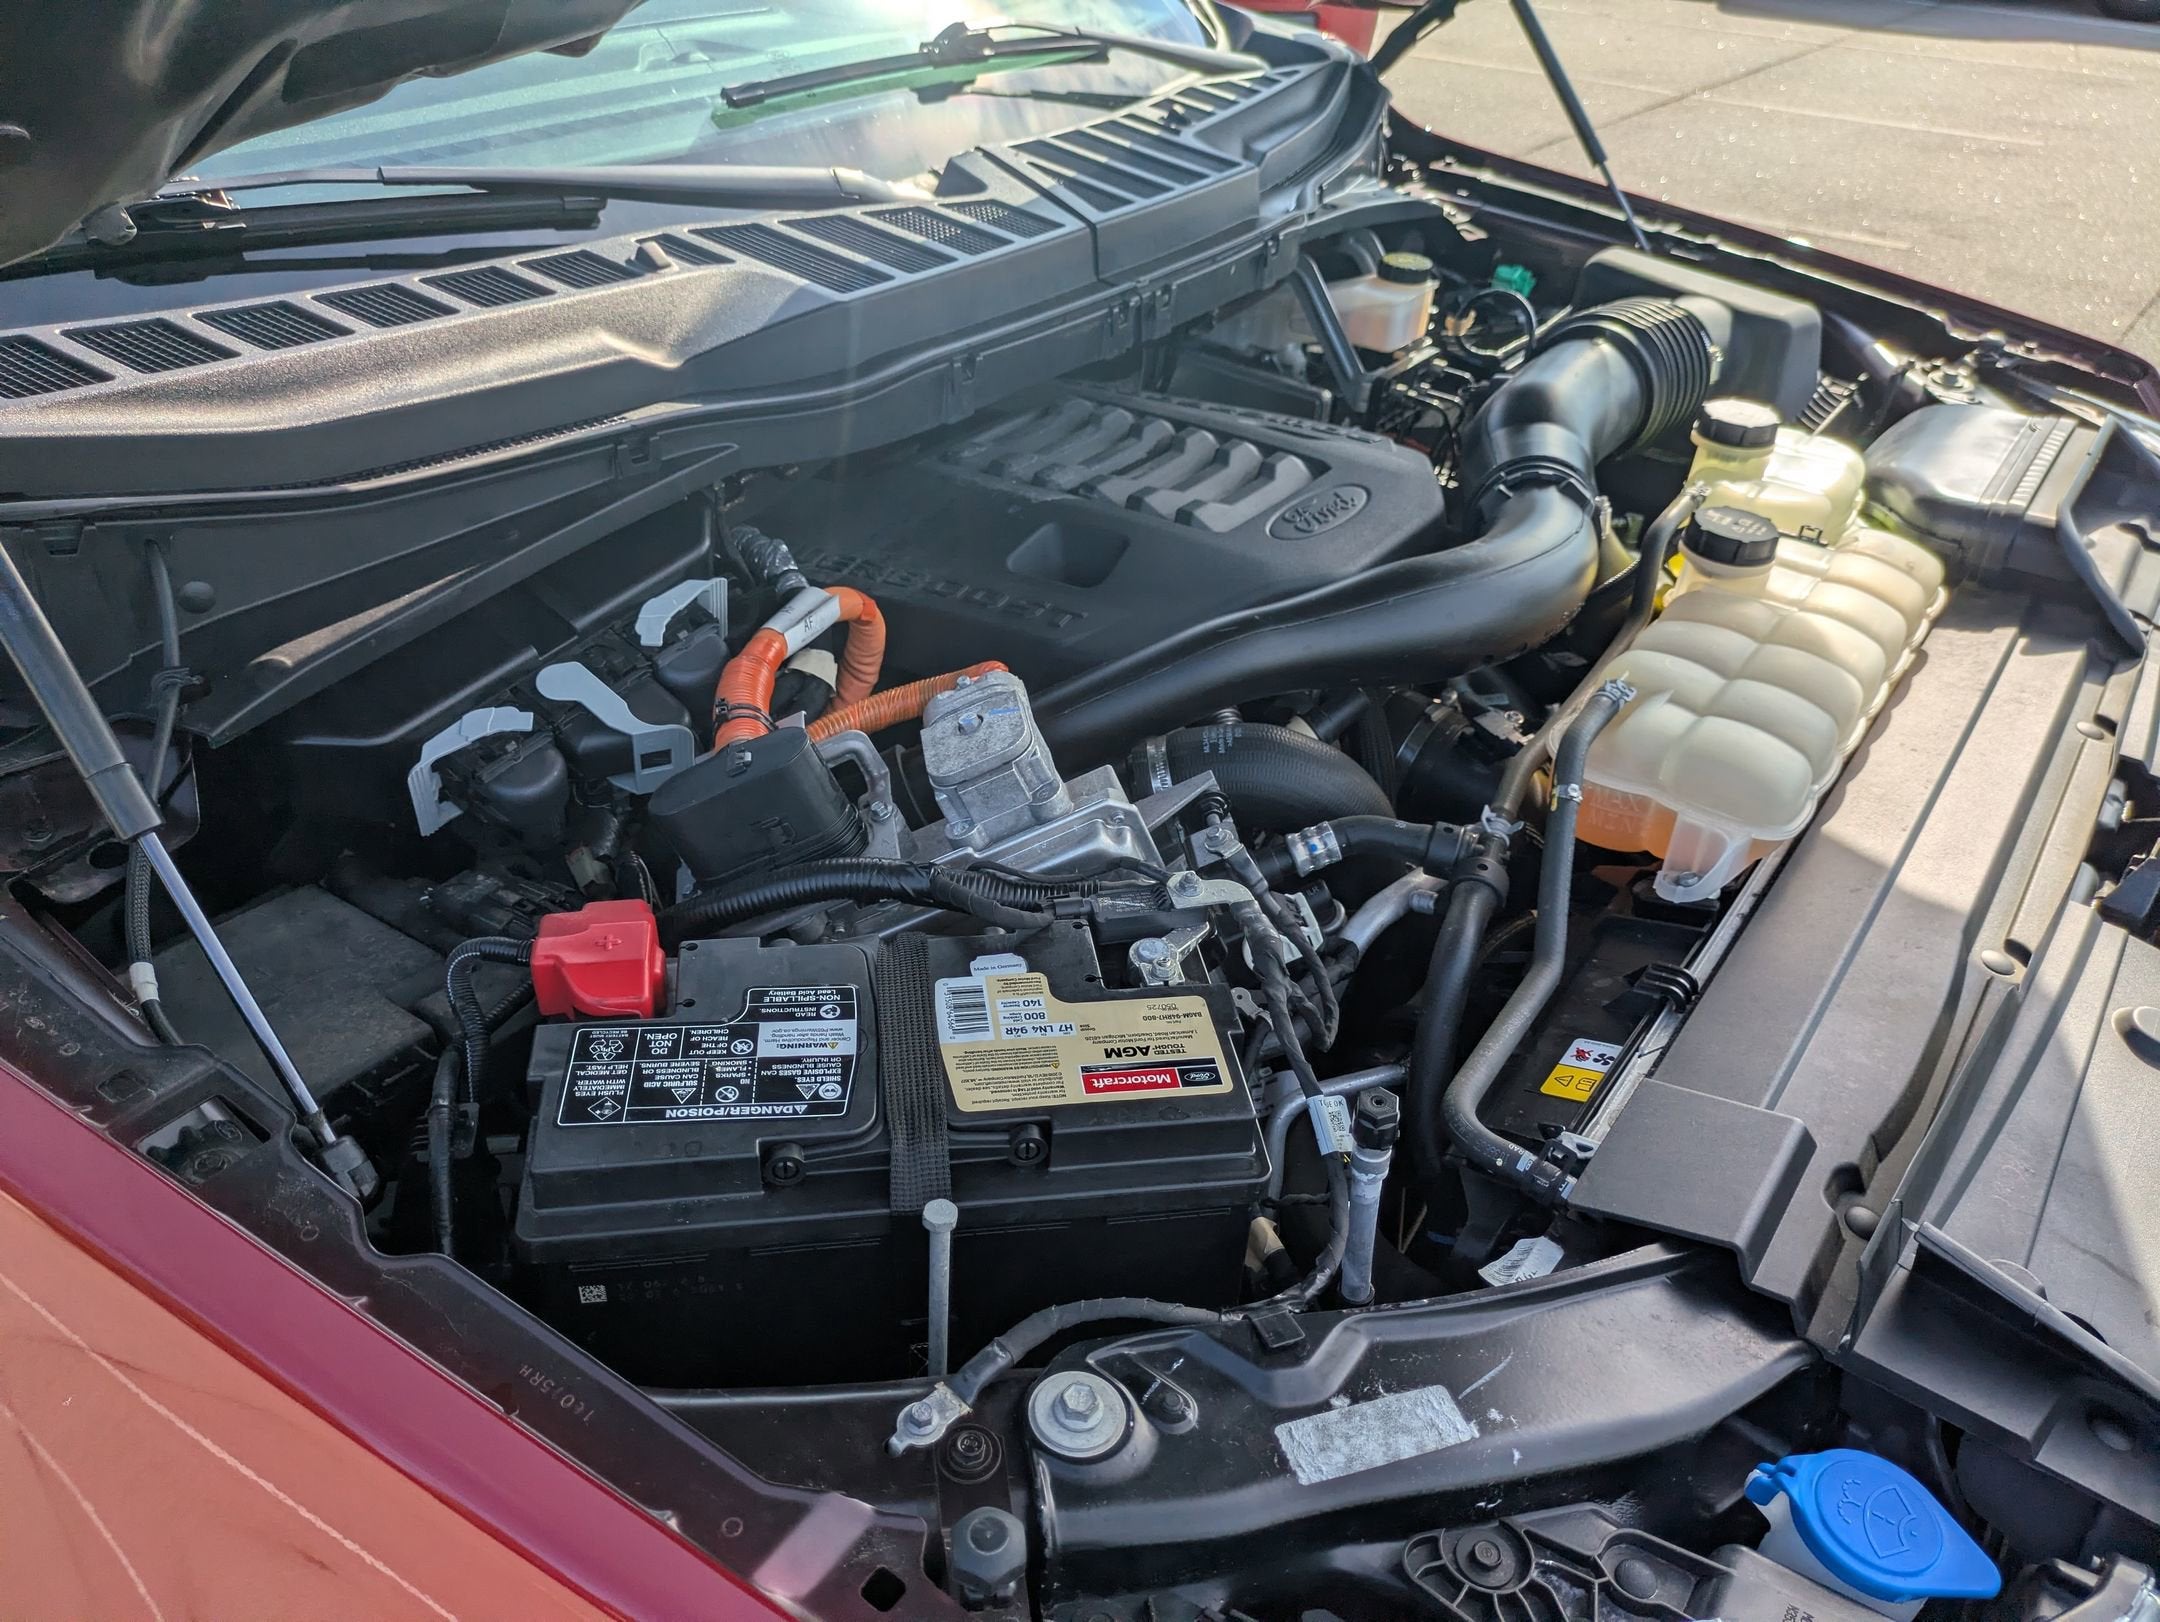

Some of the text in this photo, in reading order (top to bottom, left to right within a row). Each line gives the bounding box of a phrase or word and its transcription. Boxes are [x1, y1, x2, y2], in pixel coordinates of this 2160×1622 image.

[1282, 492, 1356, 534] Ford
[763, 994, 840, 1002] NON-SPILLABLE
[1022, 999, 1042, 1007] 140
[1024, 1012, 1045, 1020] 800
[1005, 1026, 1028, 1034] 94R
[1031, 1025, 1053, 1033] LN4
[644, 1032, 677, 1040] OPEN.
[1102, 1032, 1125, 1040] Michigan
[1104, 1045, 1150, 1058] AGM
[1092, 1073, 1171, 1088] Motorcraft
[665, 1105, 793, 1117] DANGER/POISON
[1509, 1143, 1524, 1155] RAD
